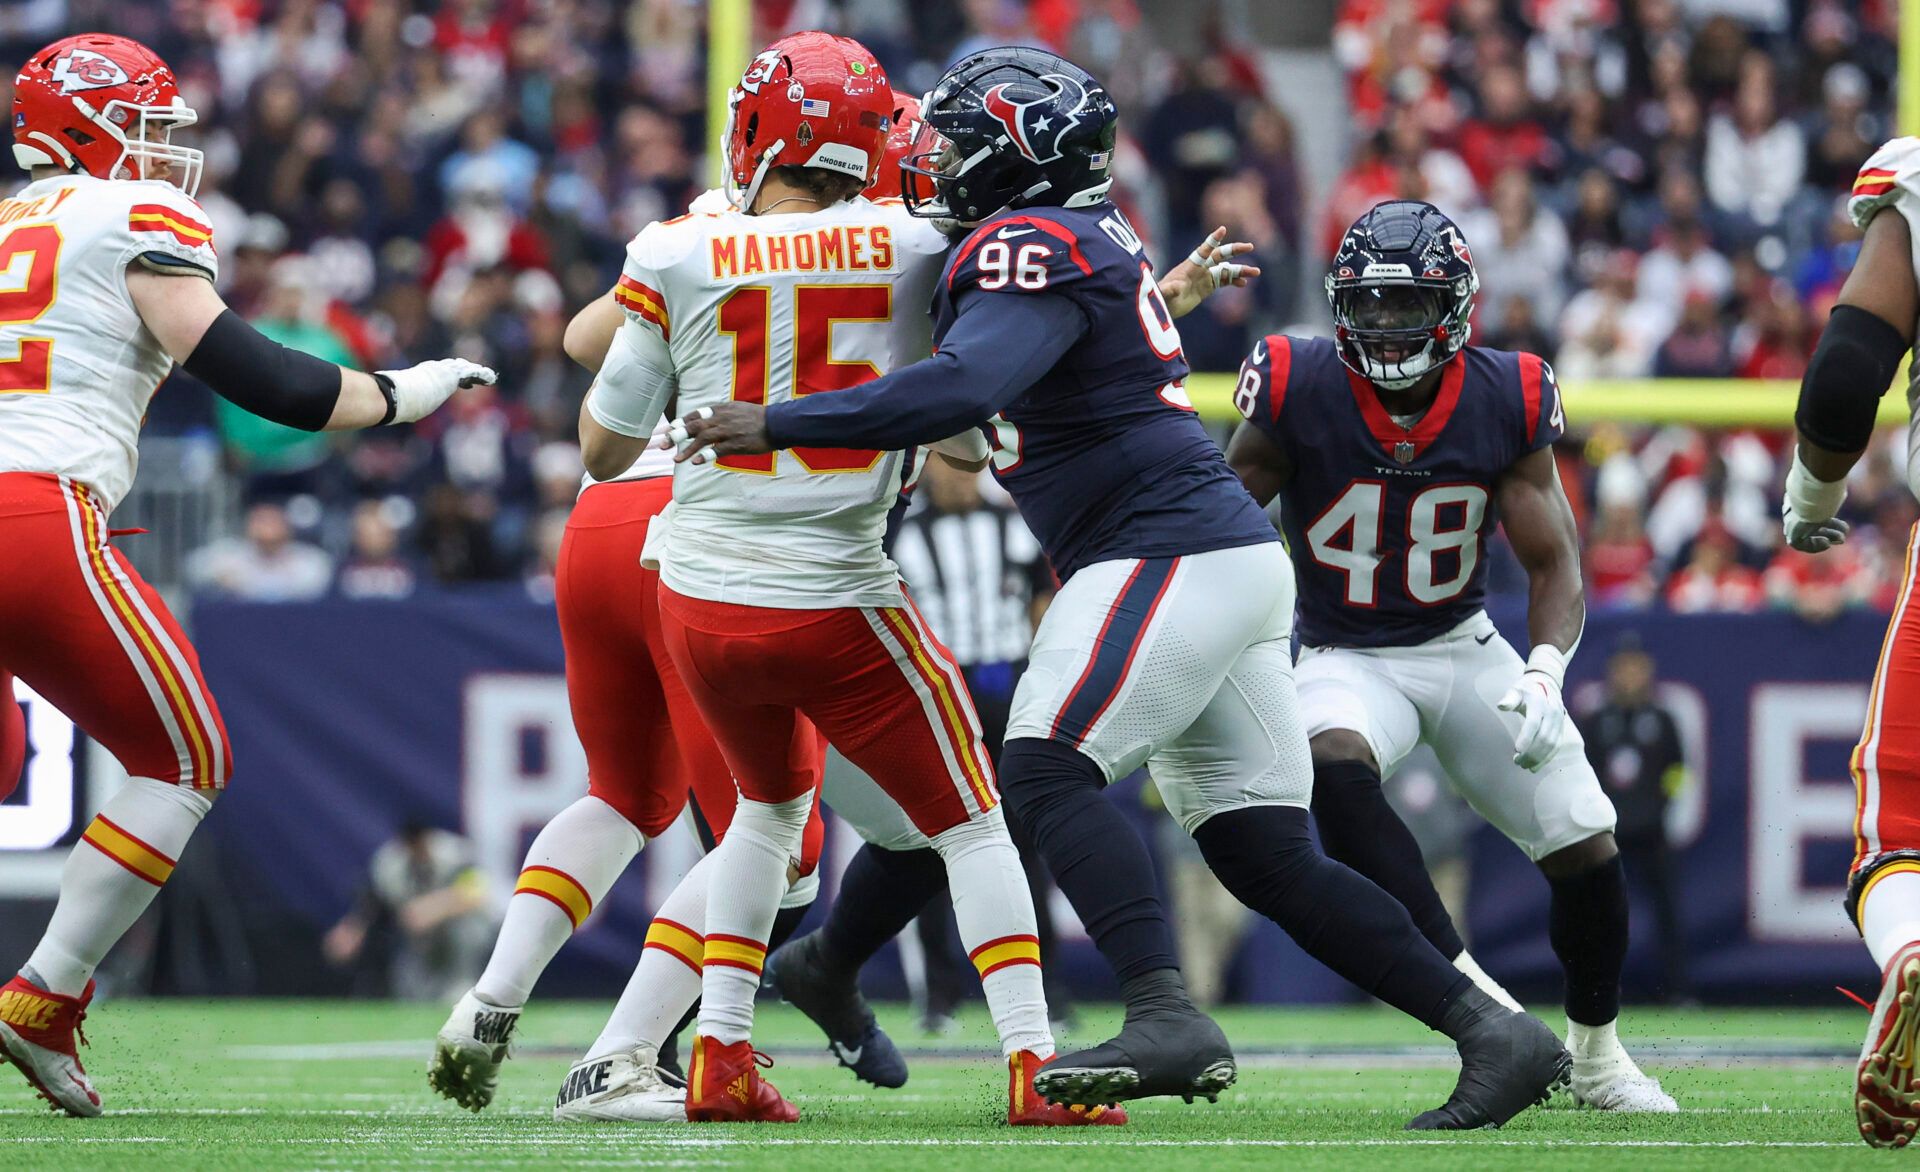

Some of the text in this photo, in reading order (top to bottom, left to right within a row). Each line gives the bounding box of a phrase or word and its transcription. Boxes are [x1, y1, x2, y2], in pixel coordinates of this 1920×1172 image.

[818, 155, 864, 172] CHOOSE LOVE
[711, 226, 893, 280] MAHOMES
[976, 241, 1054, 292] 96
[713, 283, 893, 476] 15
[1234, 359, 1263, 420] 8
[1374, 465, 1432, 477] TEXANS
[1303, 478, 1491, 609] 48
[0, 990, 63, 1031] NIKE
[556, 1059, 614, 1109] NIKE
